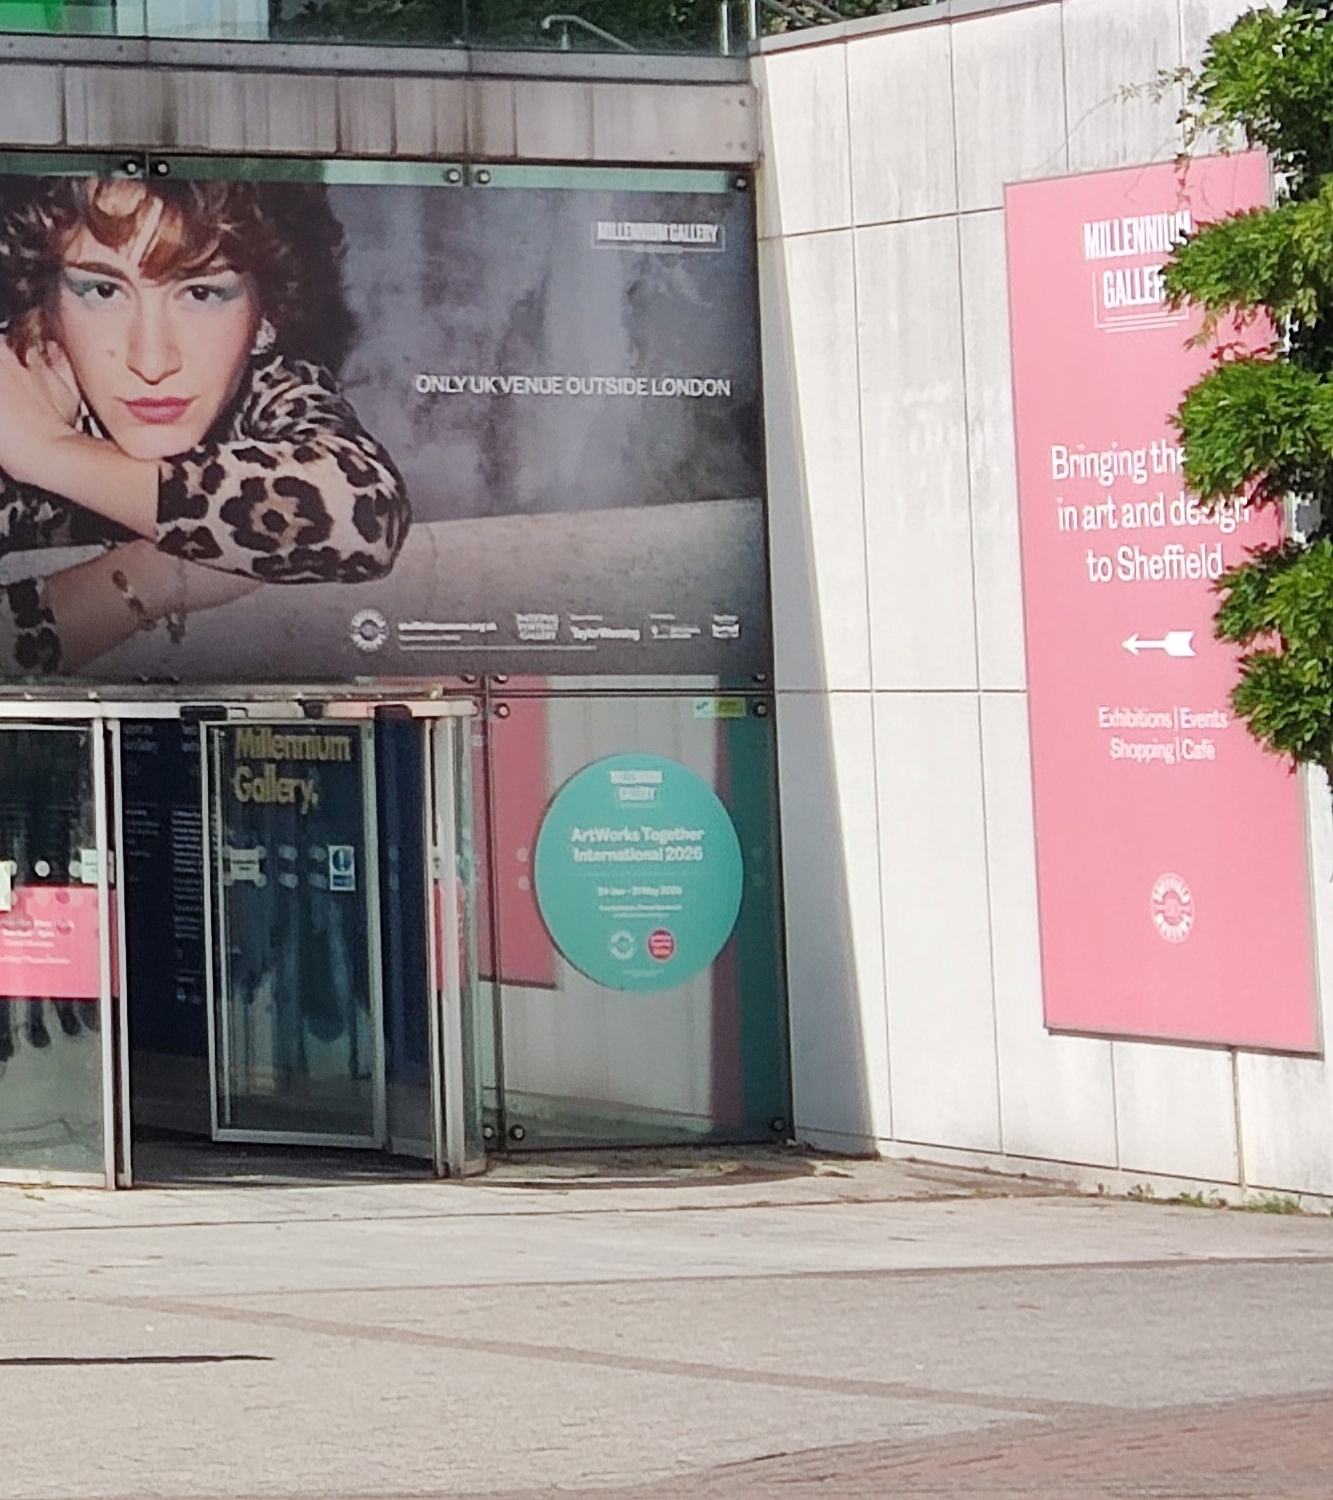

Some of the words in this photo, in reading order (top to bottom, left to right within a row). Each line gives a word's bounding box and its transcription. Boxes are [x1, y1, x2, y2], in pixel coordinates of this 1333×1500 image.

[1083, 210, 1191, 260] MILLENNIUM
[415, 374, 467, 394] ONLY
[471, 376, 497, 394] UK
[499, 376, 562, 396] VENUE
[565, 377, 648, 396] OUTSIDE
[652, 378, 731, 397] LONDON
[1051, 441, 1148, 486] Bringing
[1057, 496, 1077, 531] in
[1082, 494, 1118, 531] art
[1121, 492, 1164, 528] and
[1086, 549, 1112, 582] to
[1117, 543, 1223, 581] Sheffield
[1098, 707, 1172, 728] Exhibitions
[1180, 707, 1229, 728] Events
[234, 727, 351, 761] Millennium
[1110, 737, 1175, 764] Shopping
[641, 825, 705, 845] Together
[574, 847, 664, 862] International
